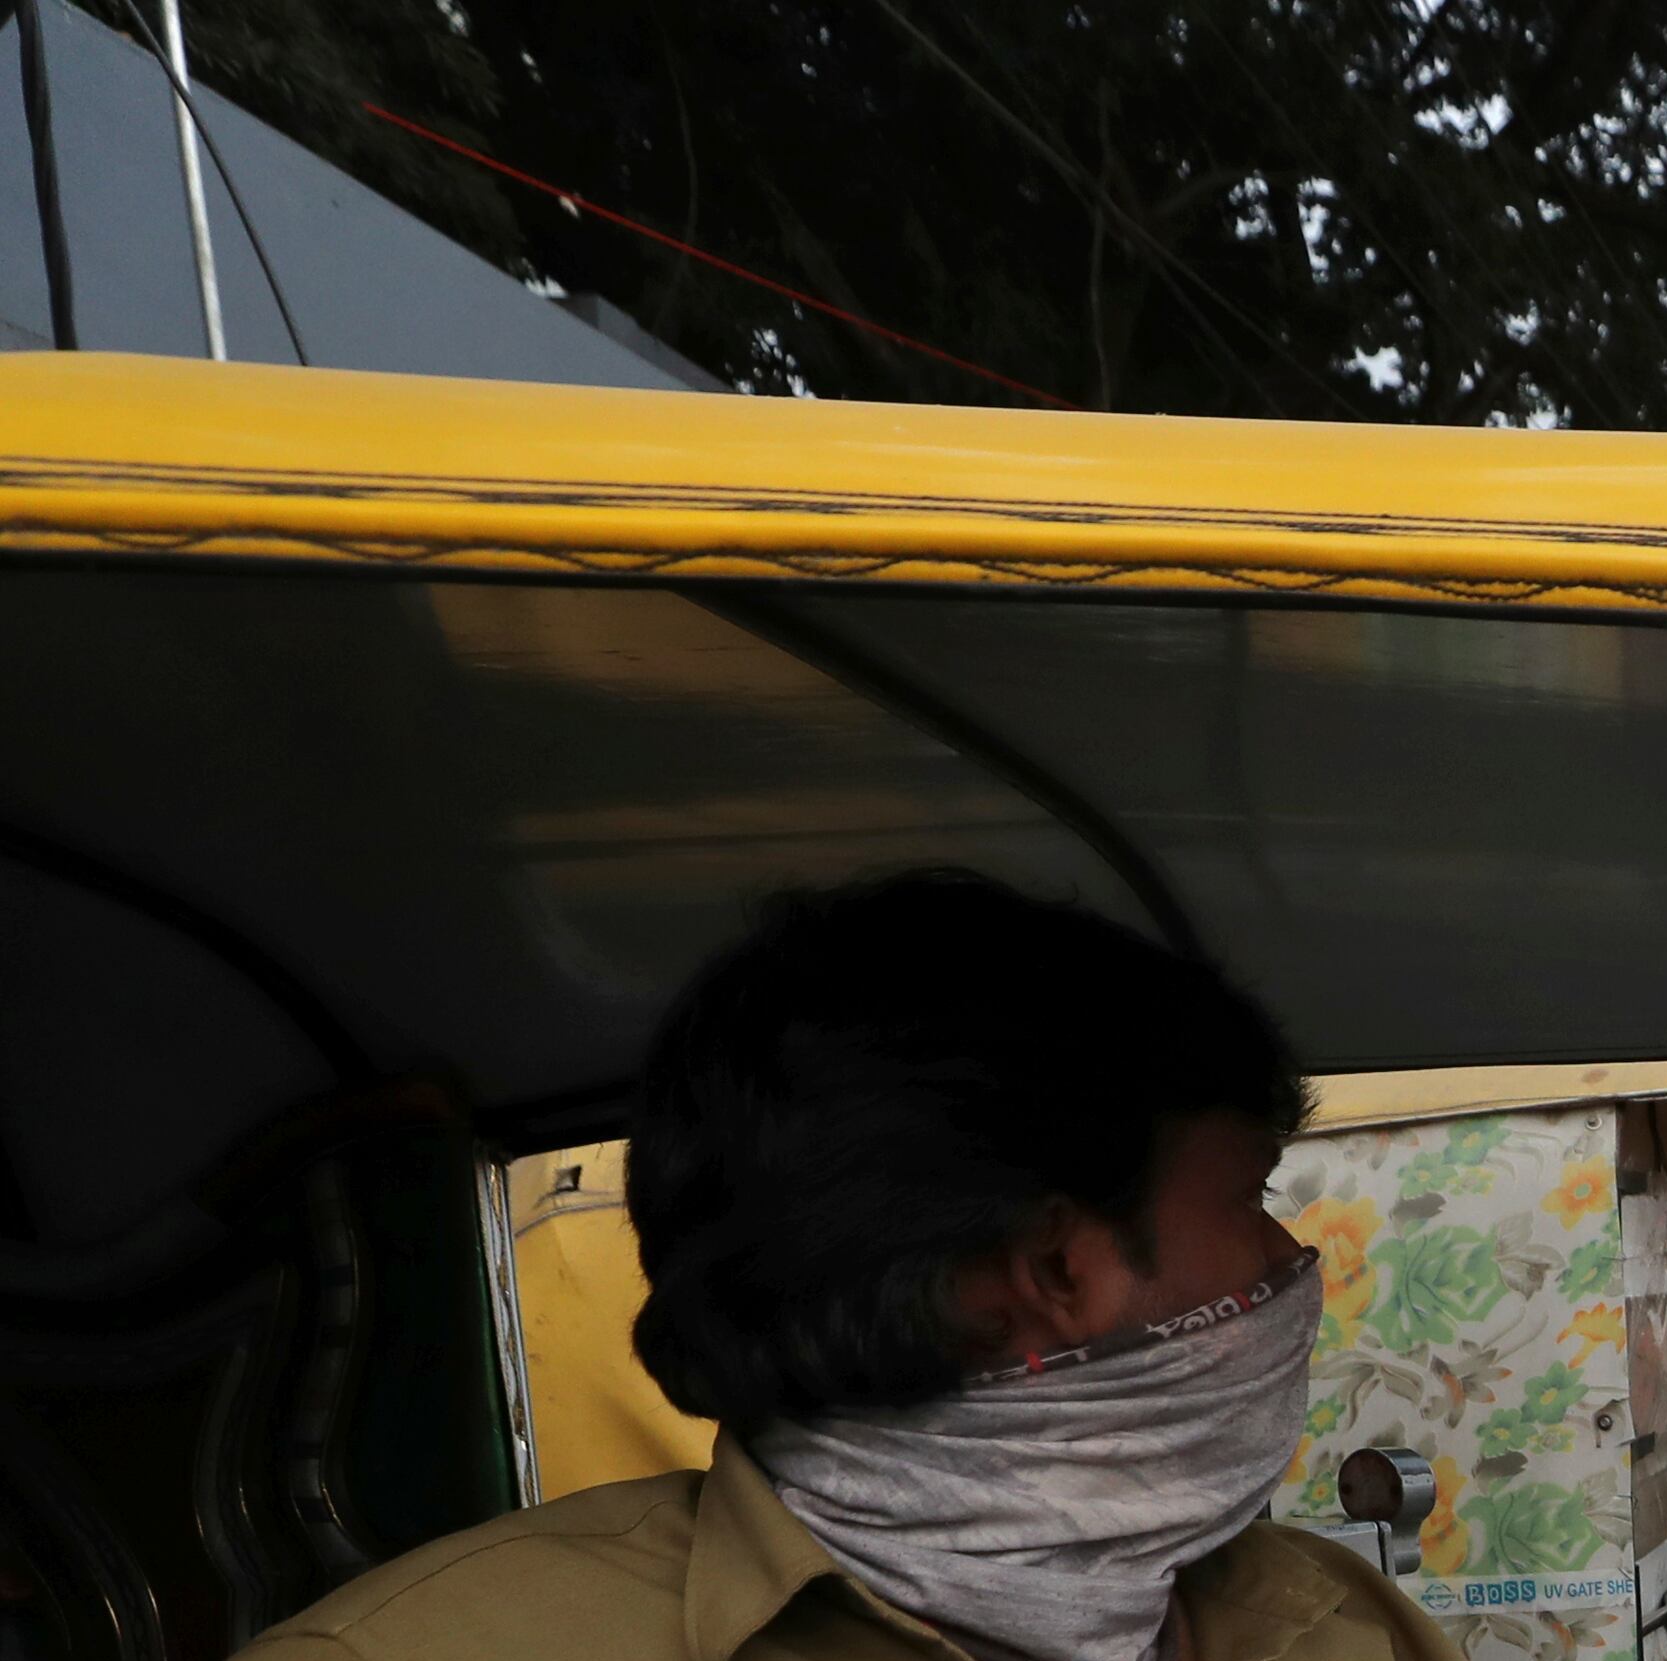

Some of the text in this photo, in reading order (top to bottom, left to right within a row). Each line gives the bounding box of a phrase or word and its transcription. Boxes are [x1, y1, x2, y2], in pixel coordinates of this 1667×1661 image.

[1465, 1580, 1536, 1607] BOSS
[1544, 1584, 1563, 1598] UV
[1567, 1581, 1602, 1597] GATE
